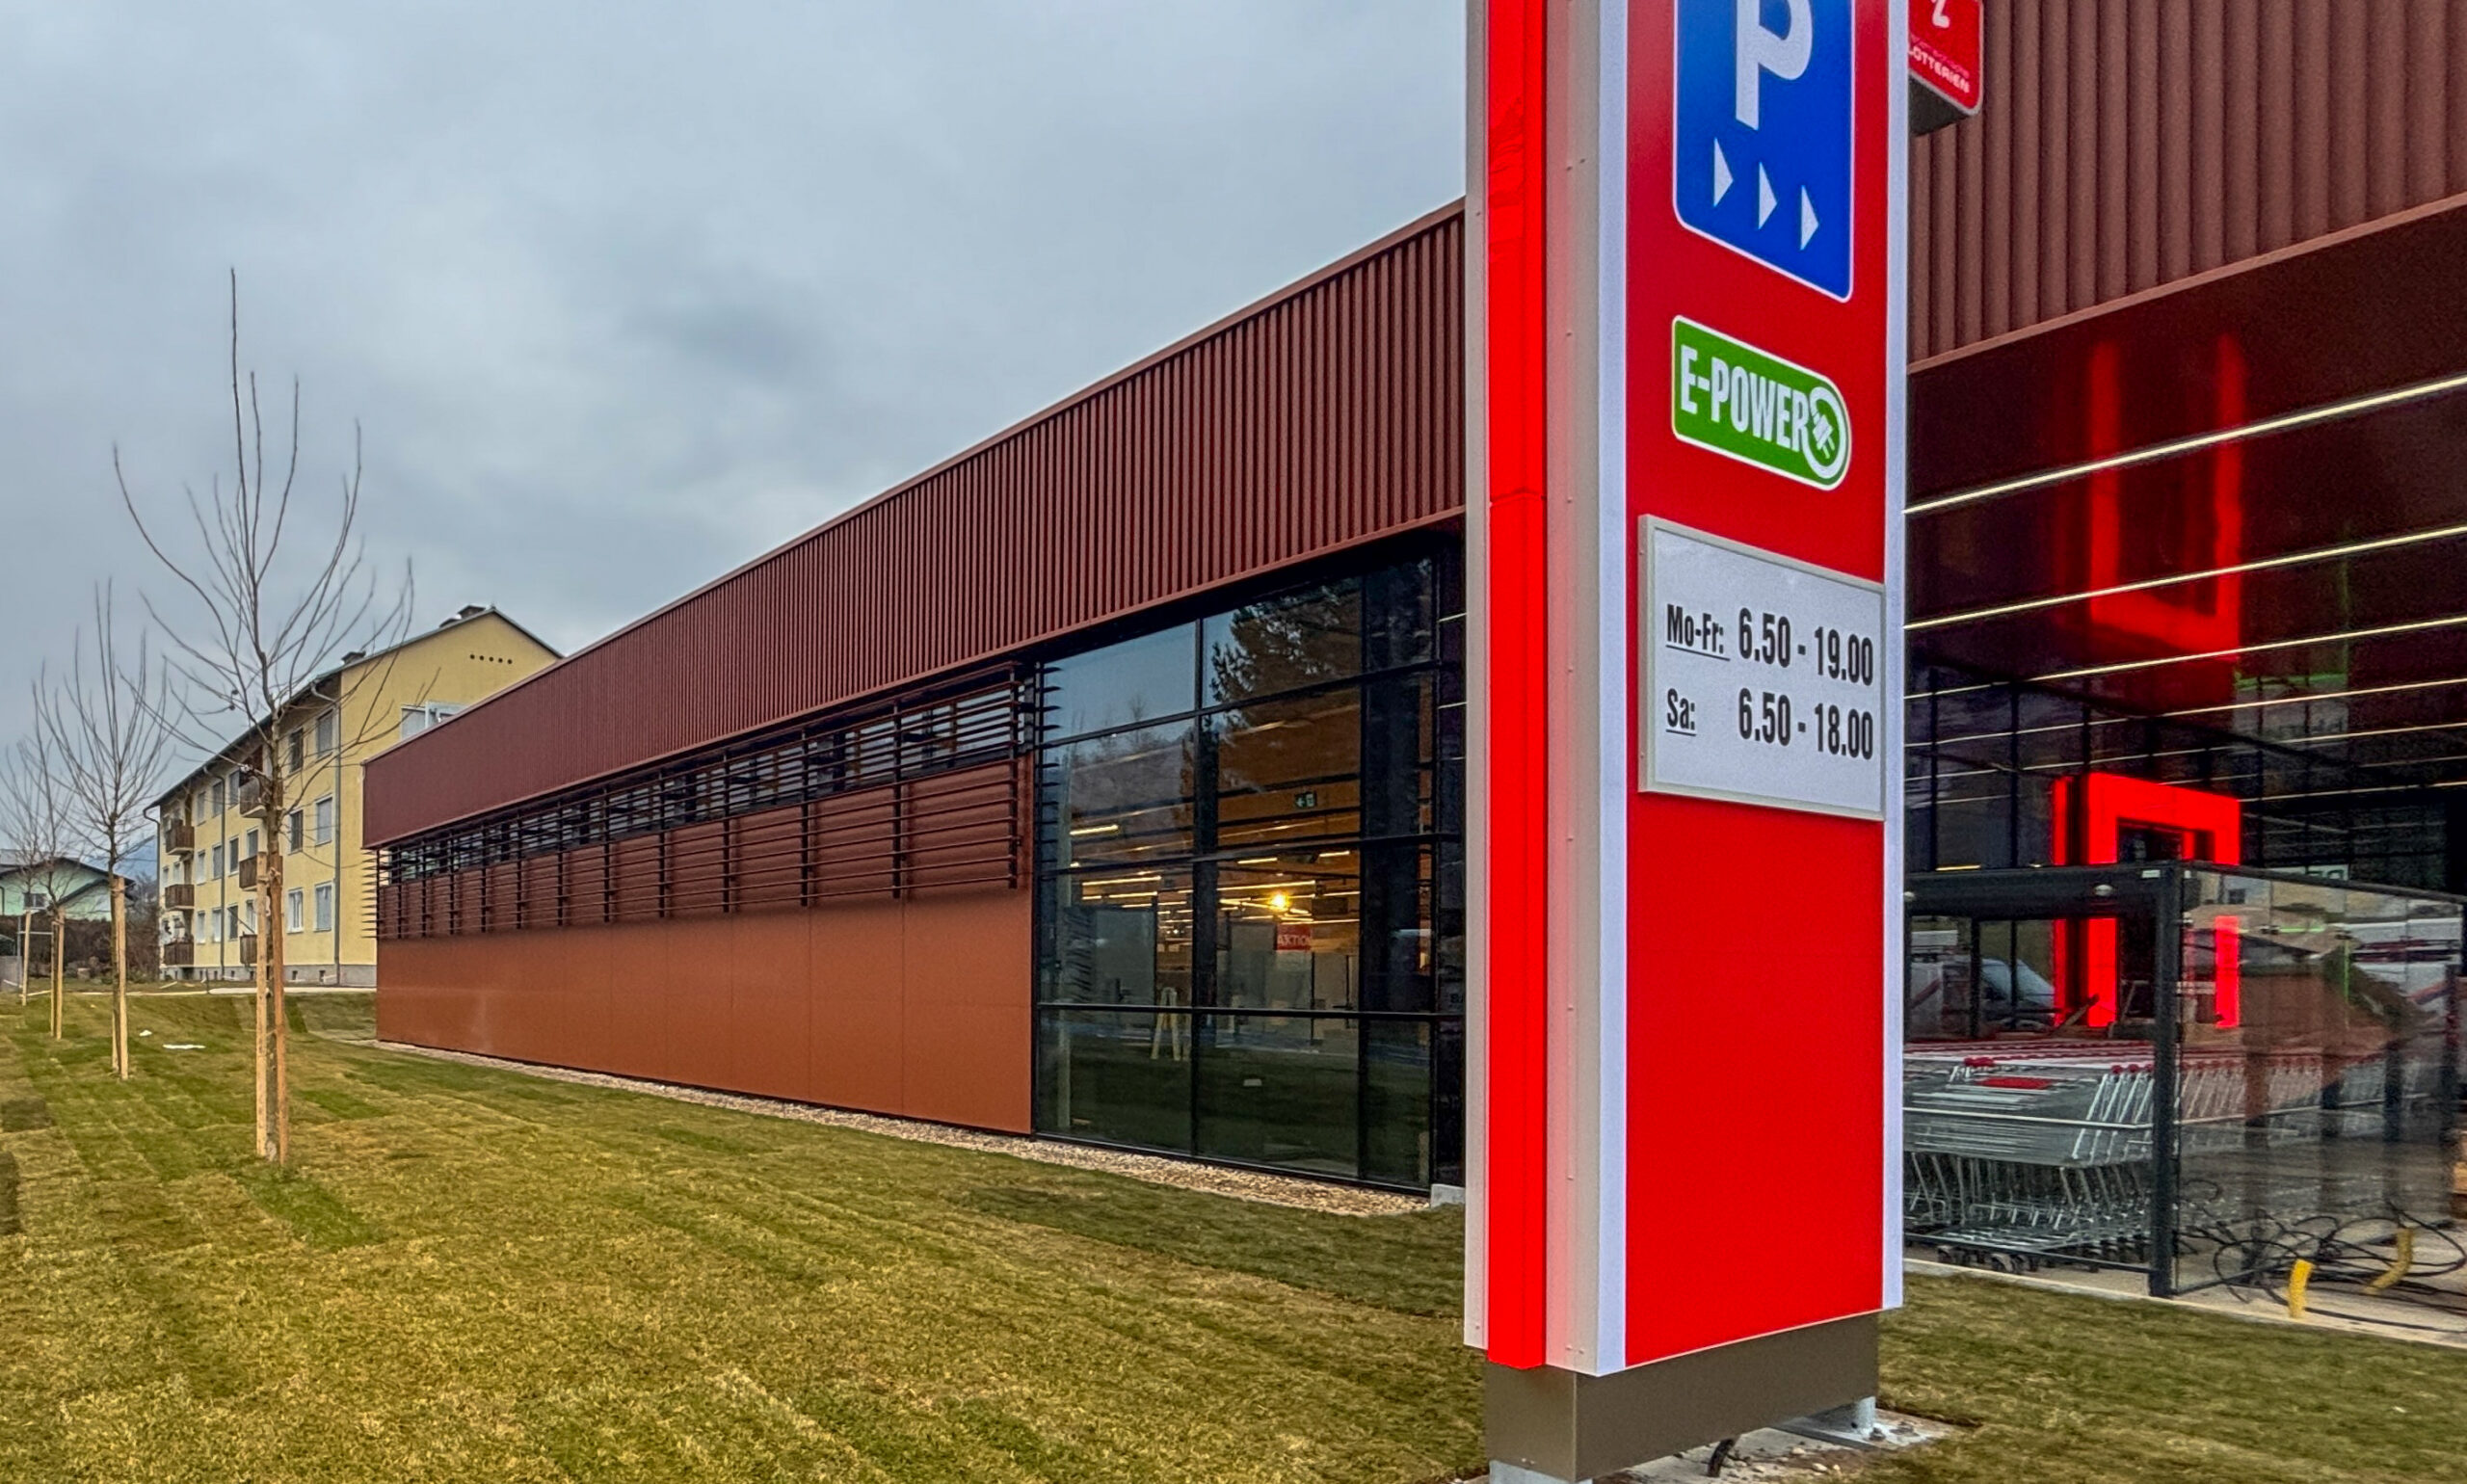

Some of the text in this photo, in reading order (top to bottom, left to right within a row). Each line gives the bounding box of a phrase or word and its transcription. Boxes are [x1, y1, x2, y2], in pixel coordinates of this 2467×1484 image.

[1736, 0, 1814, 130] P
[1681, 344, 1810, 452] E-POWER
[1667, 603, 1724, 654] Mo-Fr:
[1738, 607, 1791, 668] 6.50
[1815, 626, 1873, 686] 19.00
[1667, 688, 1695, 730] Sa:
[1738, 688, 1791, 746] 6.50
[1815, 702, 1873, 759] 18.00
